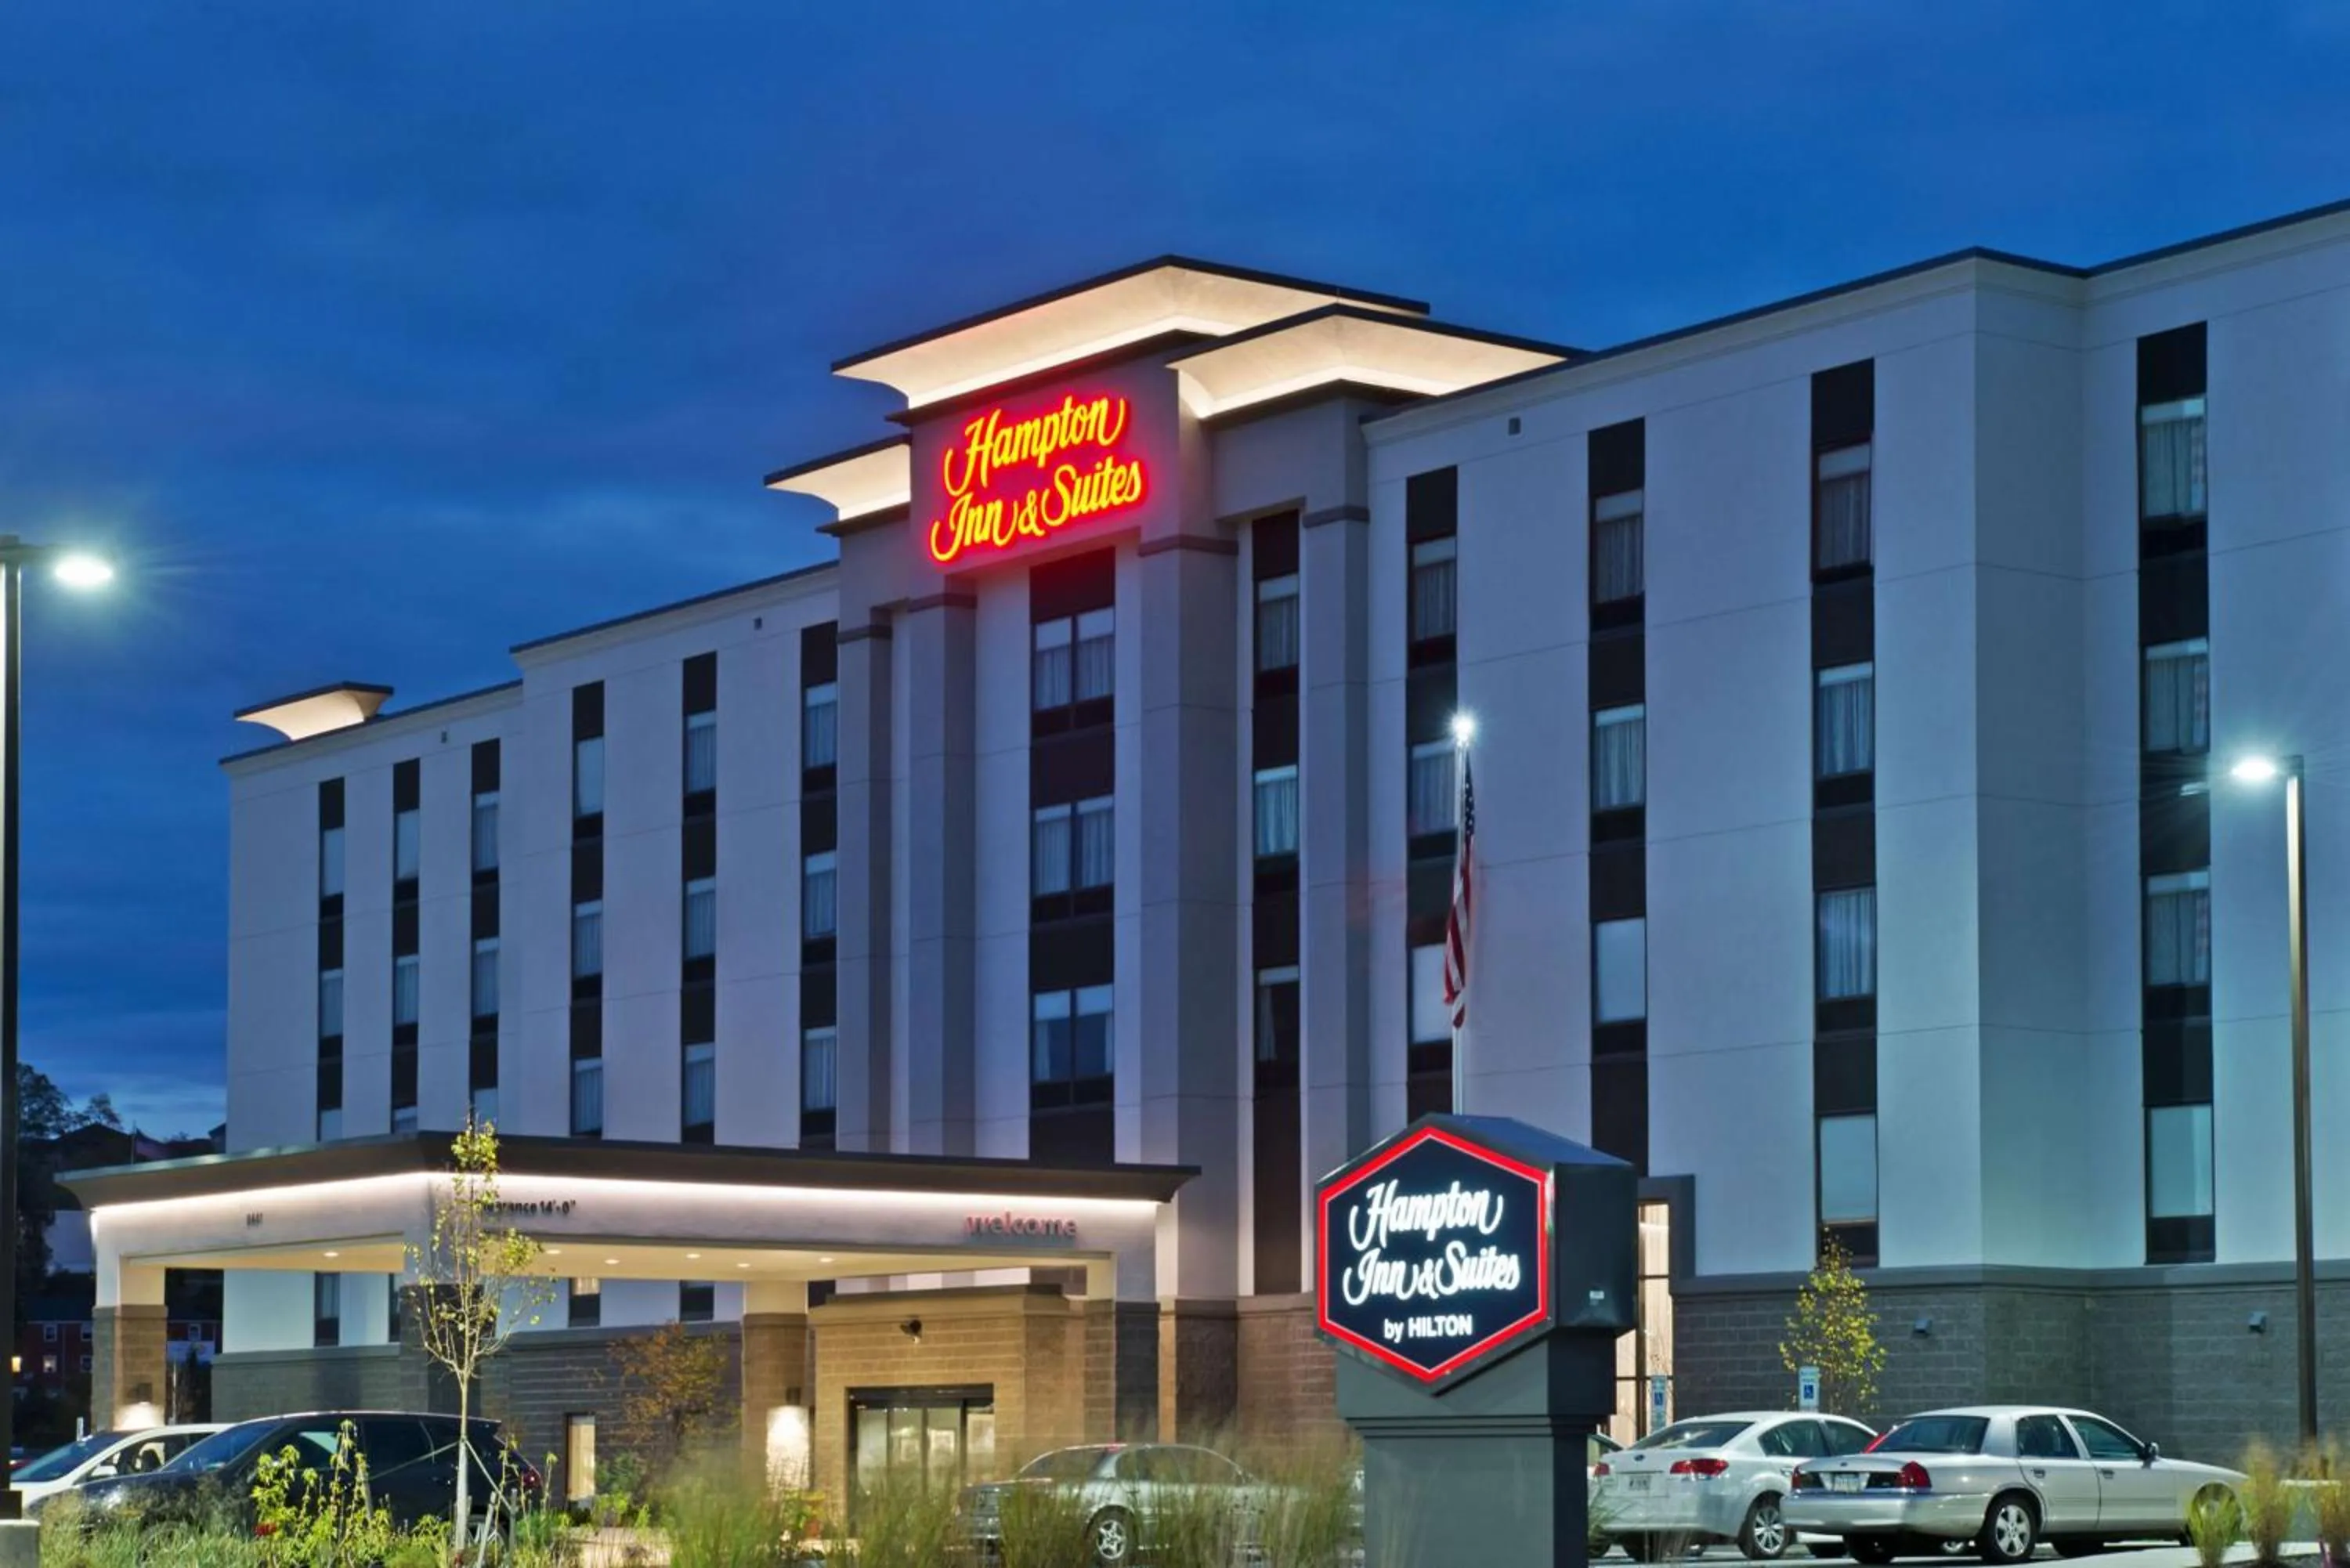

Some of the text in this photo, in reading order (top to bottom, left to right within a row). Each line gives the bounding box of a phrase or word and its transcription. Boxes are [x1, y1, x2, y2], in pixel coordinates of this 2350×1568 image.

[943, 395, 1126, 497] Hampton
[931, 455, 1141, 562] Inn & Suites
[964, 1211, 1078, 1237] welcome
[1348, 1178, 1504, 1252] Hampton
[1342, 1240, 1520, 1306] Inn & Suites
[1383, 1314, 1473, 1343] by HILTON
